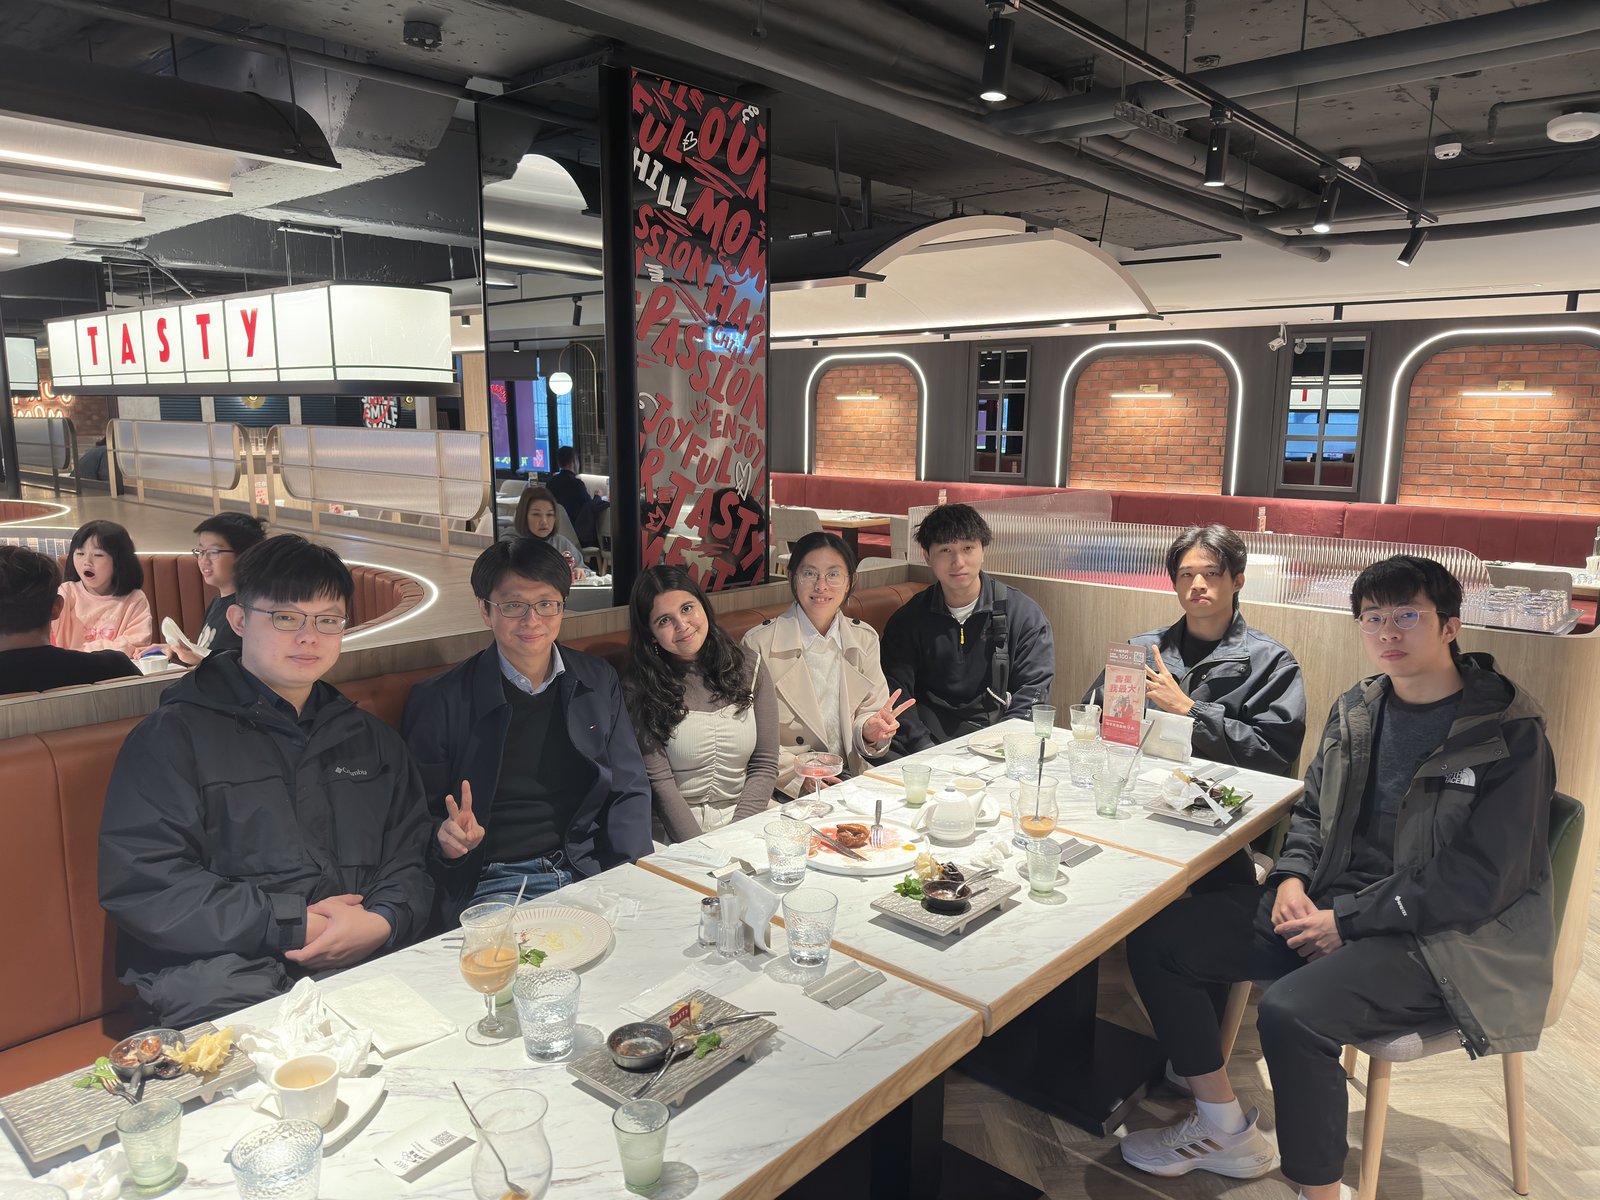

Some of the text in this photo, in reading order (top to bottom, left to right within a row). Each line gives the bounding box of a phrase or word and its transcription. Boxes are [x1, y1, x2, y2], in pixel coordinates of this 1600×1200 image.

[87, 308, 258, 365] TASTY
[712, 324, 745, 365] CHILL
[643, 392, 734, 486] JOYFUL
[709, 409, 765, 467] ENJOY
[665, 471, 766, 572] TASTY
